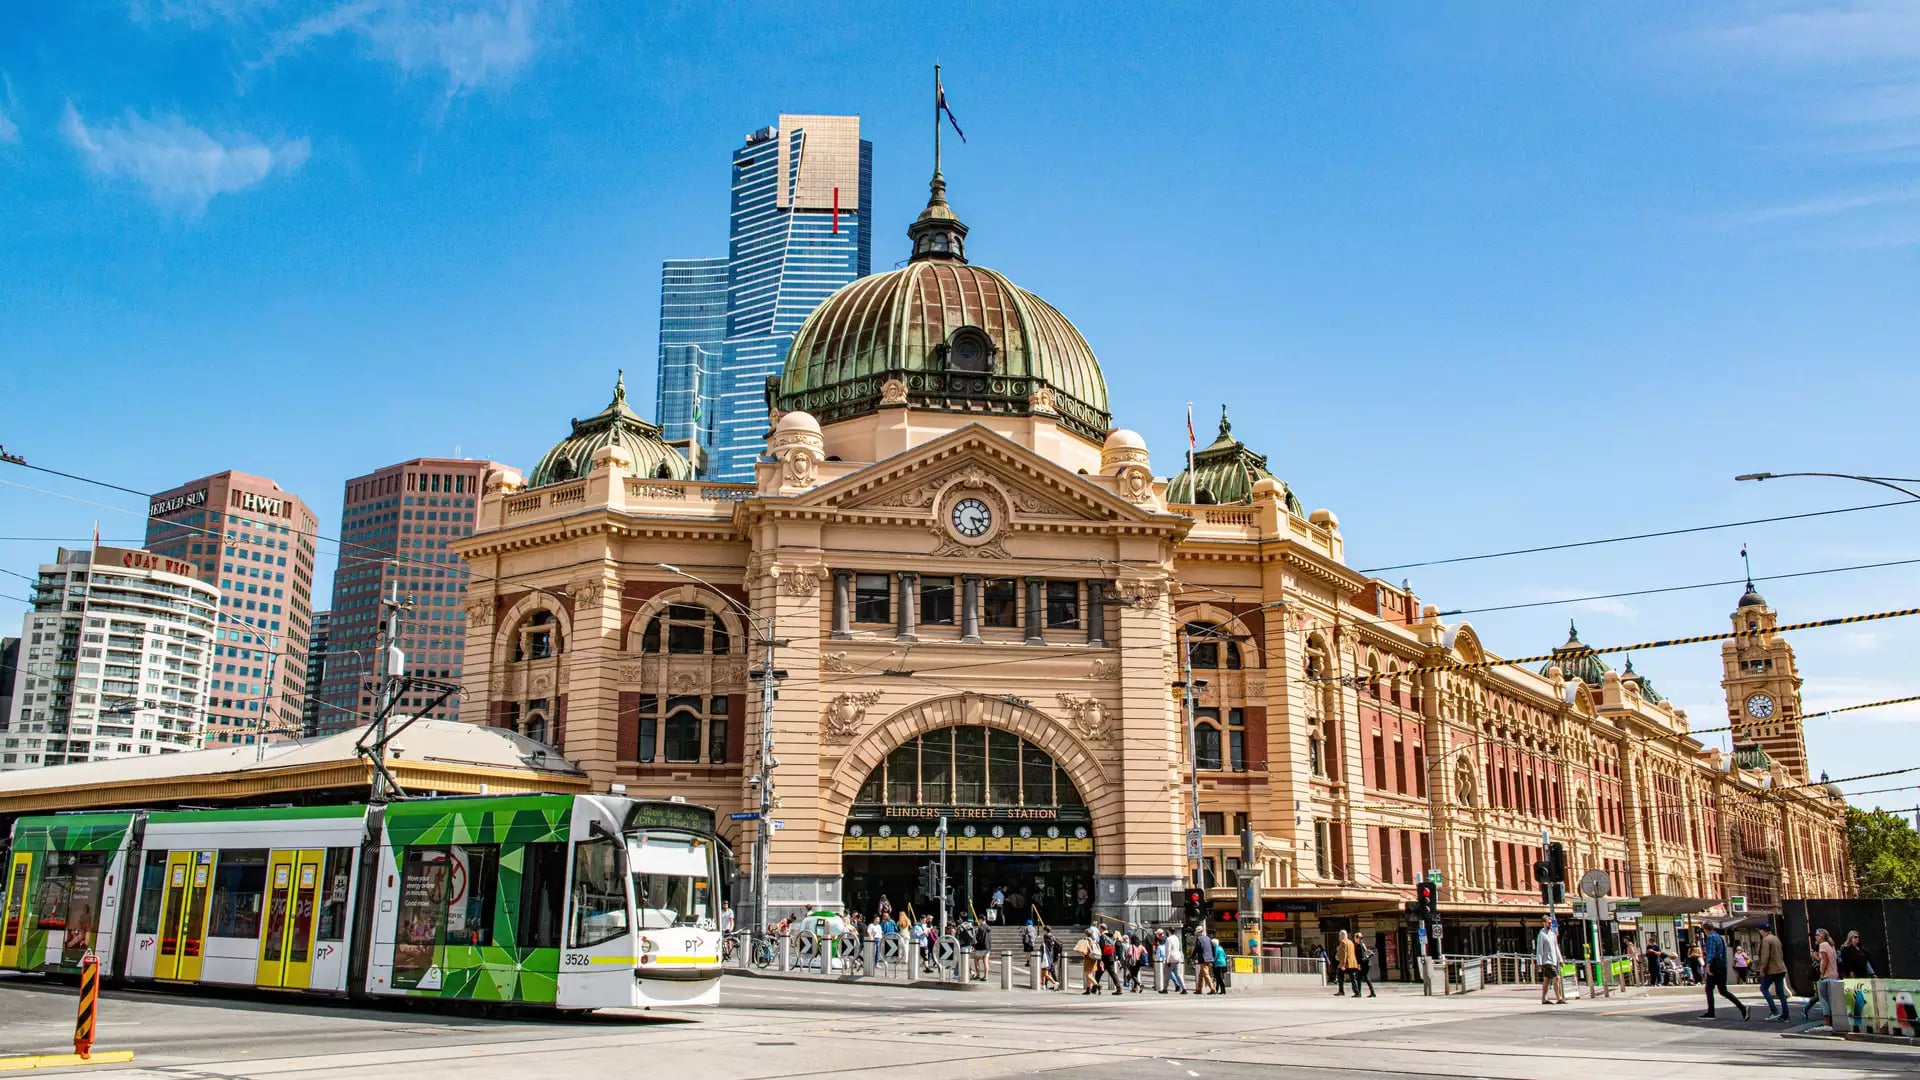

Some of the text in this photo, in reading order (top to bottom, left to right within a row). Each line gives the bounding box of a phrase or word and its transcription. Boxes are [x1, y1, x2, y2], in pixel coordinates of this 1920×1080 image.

[186, 489, 206, 505] SUN
[244, 493, 280, 514] HWT
[123, 552, 190, 577] QUAY WEST
[885, 807, 1057, 819] FLINDERS STREET STATION
[565, 953, 590, 966] 3526
